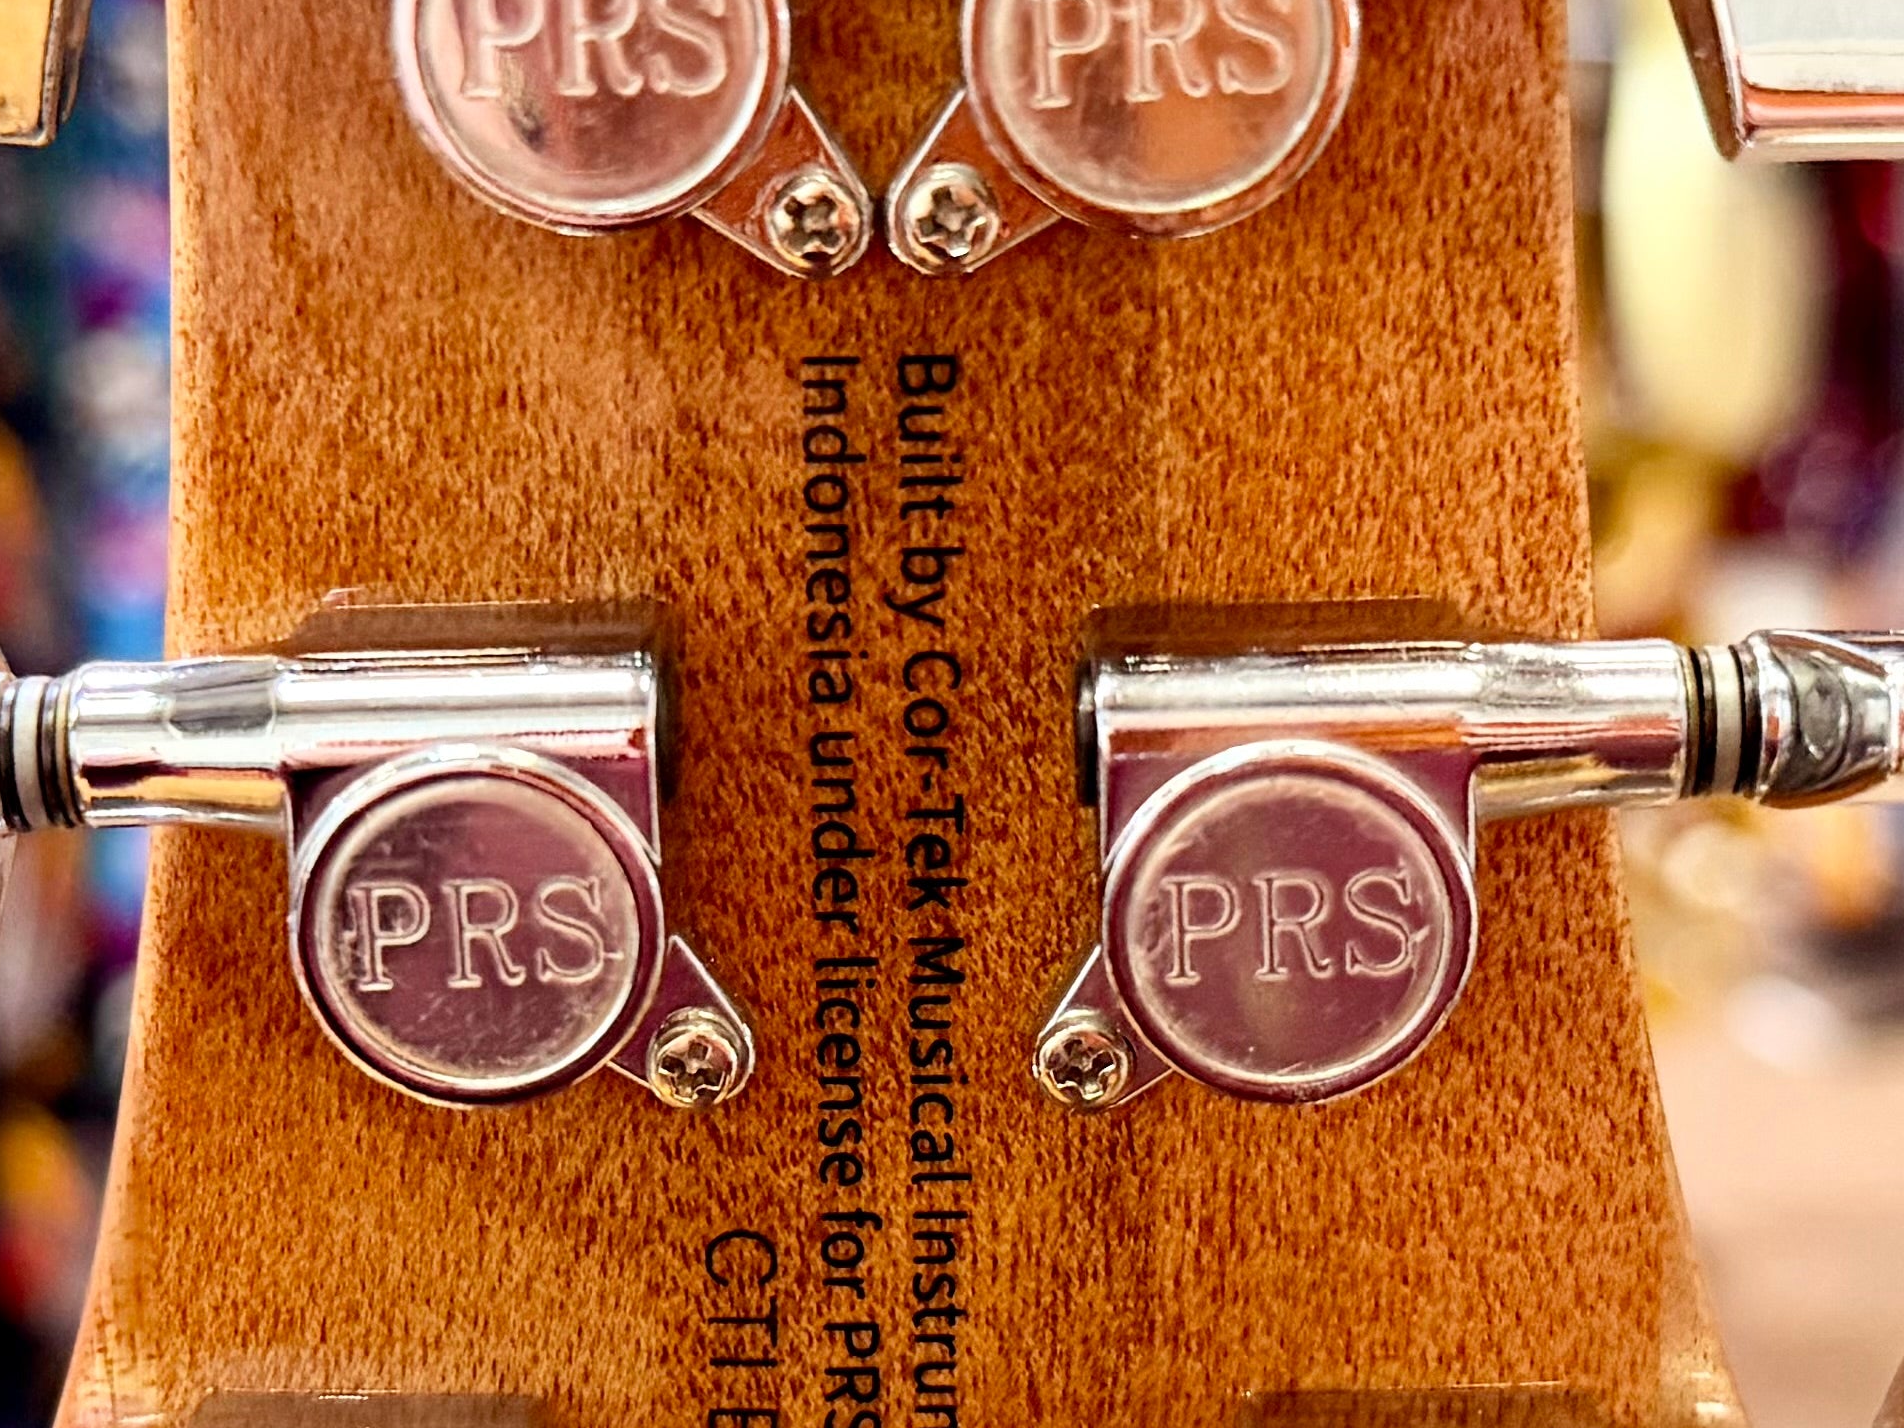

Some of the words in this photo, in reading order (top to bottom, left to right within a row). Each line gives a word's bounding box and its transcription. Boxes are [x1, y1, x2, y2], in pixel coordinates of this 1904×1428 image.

[896, 353, 962, 520] Built
[800, 355, 869, 704] Indonesia
[882, 547, 964, 624] by
[809, 731, 876, 932] under
[900, 650, 969, 912] Cor-Tek
[348, 875, 604, 991] PRS
[1161, 868, 1415, 985] PRS
[814, 956, 878, 1188] license
[907, 936, 972, 1187] Musical
[819, 1209, 883, 1300] for
